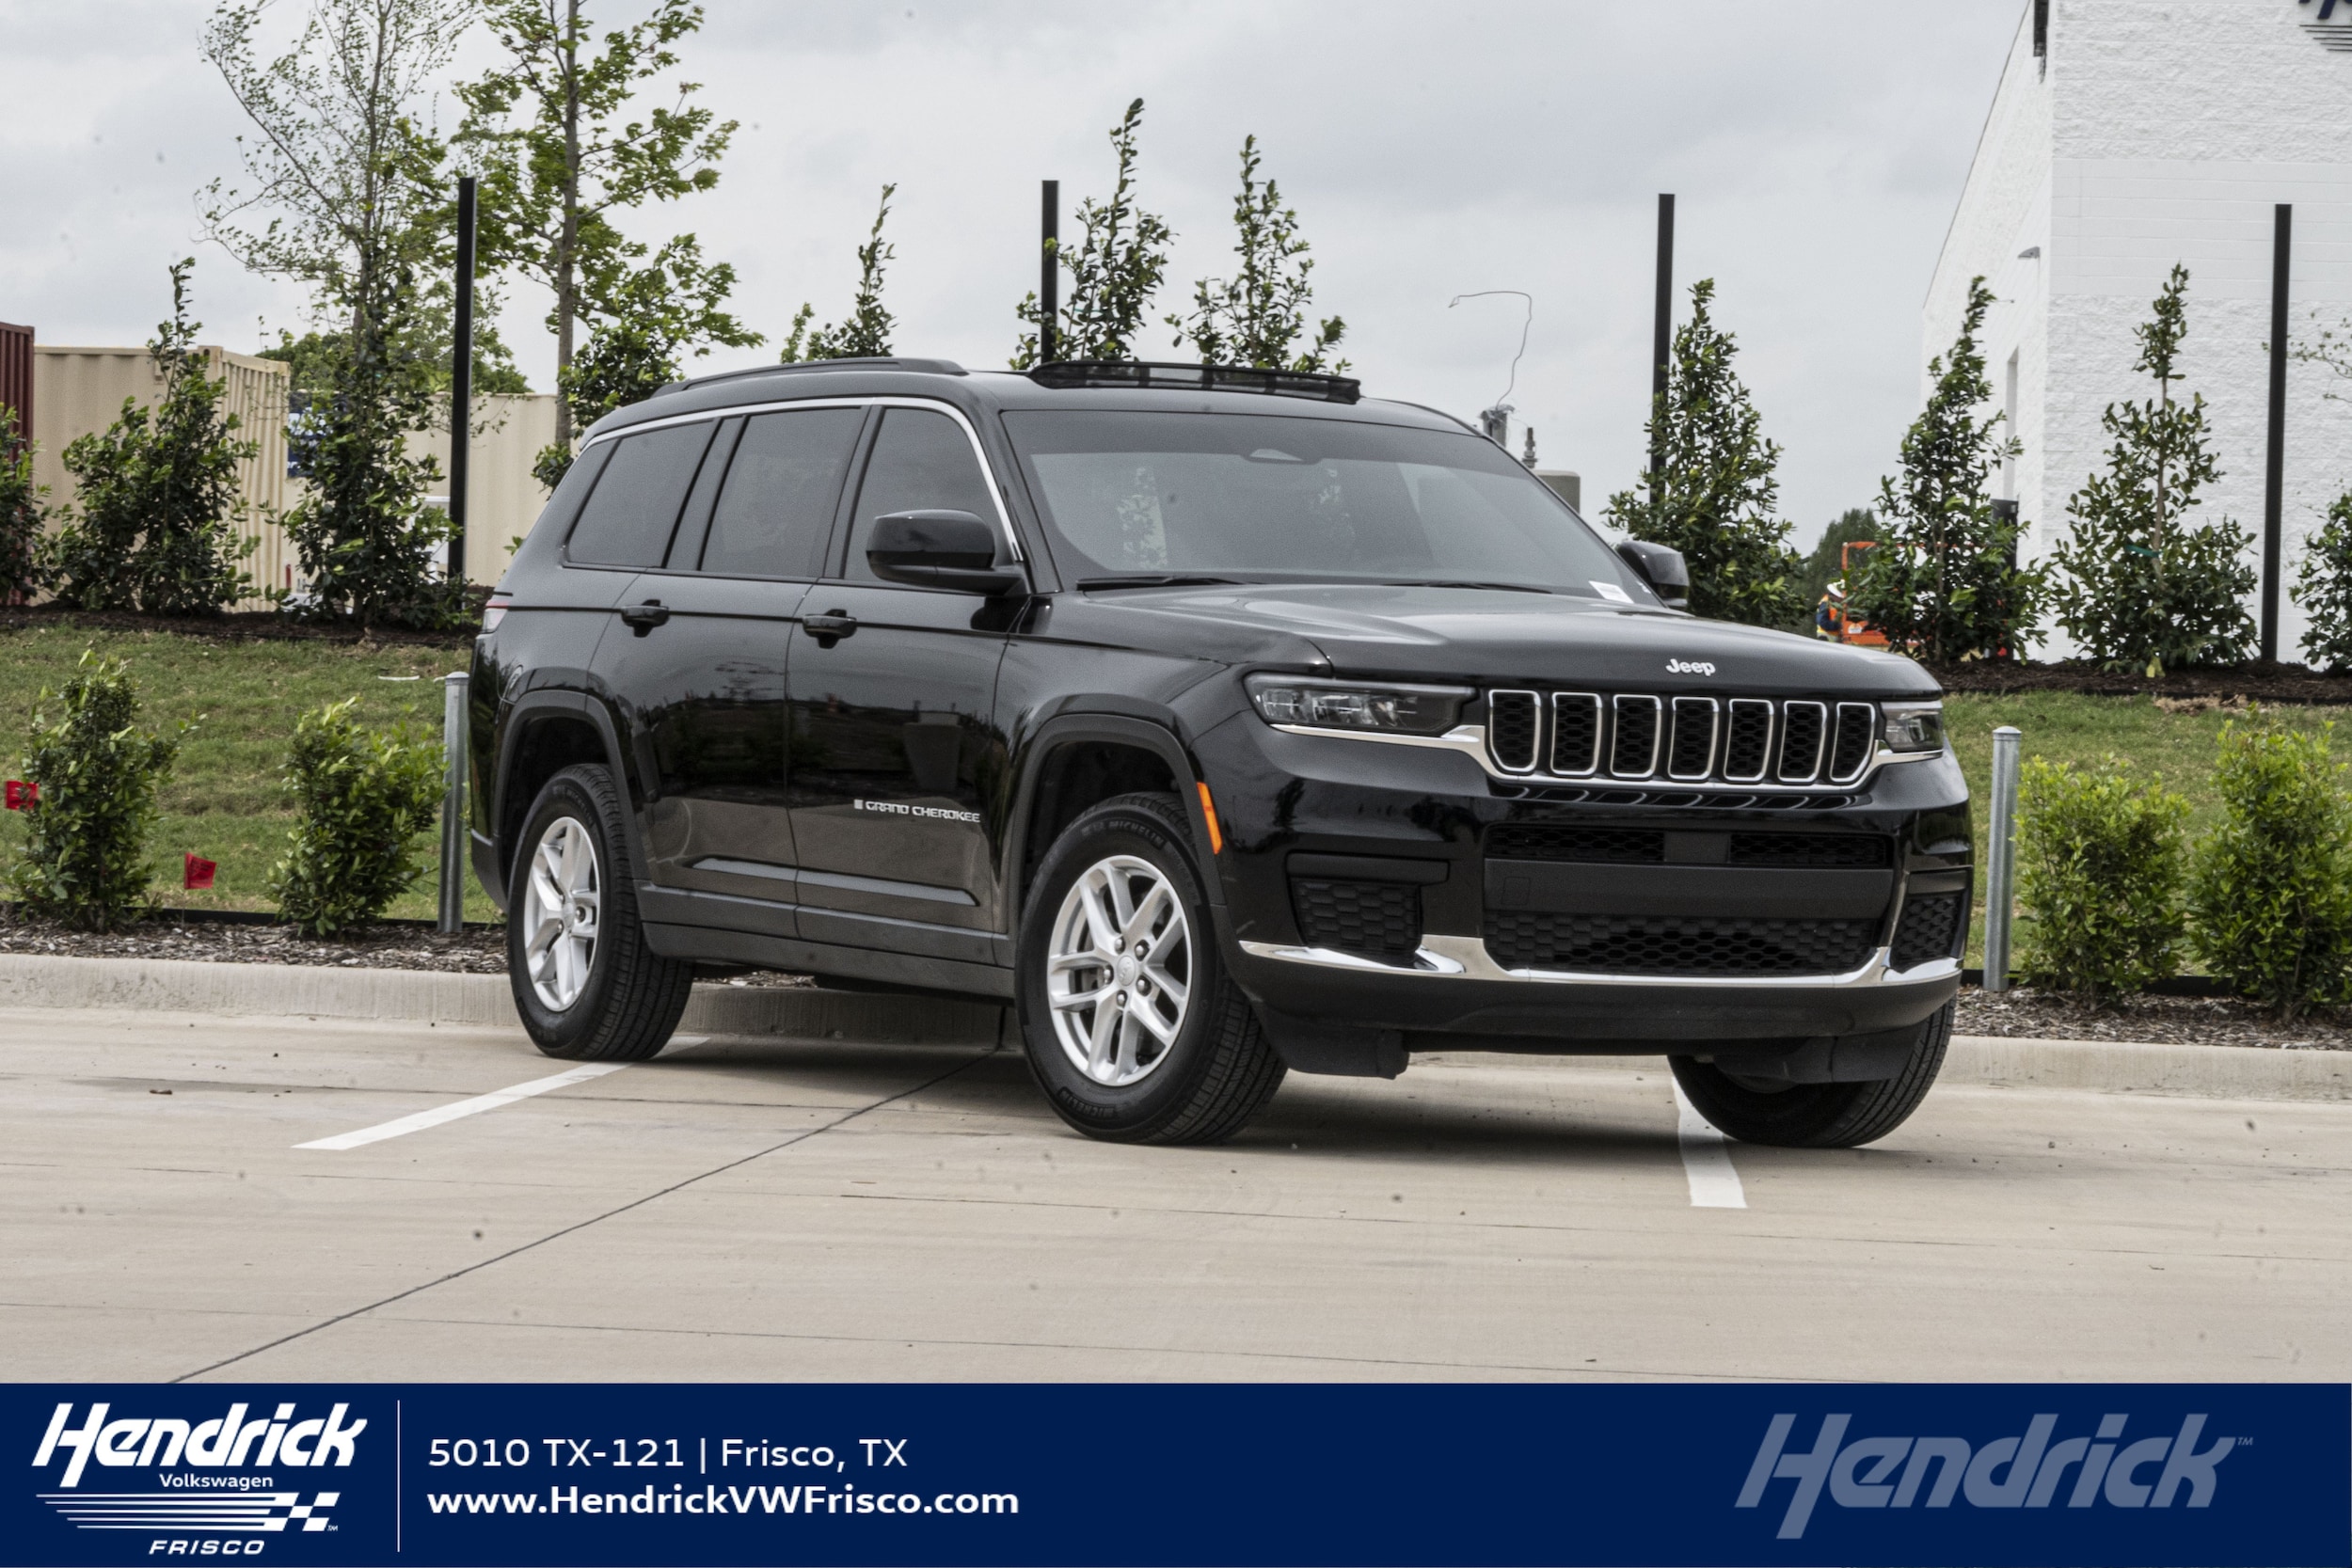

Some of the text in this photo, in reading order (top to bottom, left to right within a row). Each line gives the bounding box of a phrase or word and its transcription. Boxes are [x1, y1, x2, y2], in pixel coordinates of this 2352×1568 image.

[1665, 658, 1716, 676] Jeep
[865, 800, 981, 823] GRAND CHEROKEE
